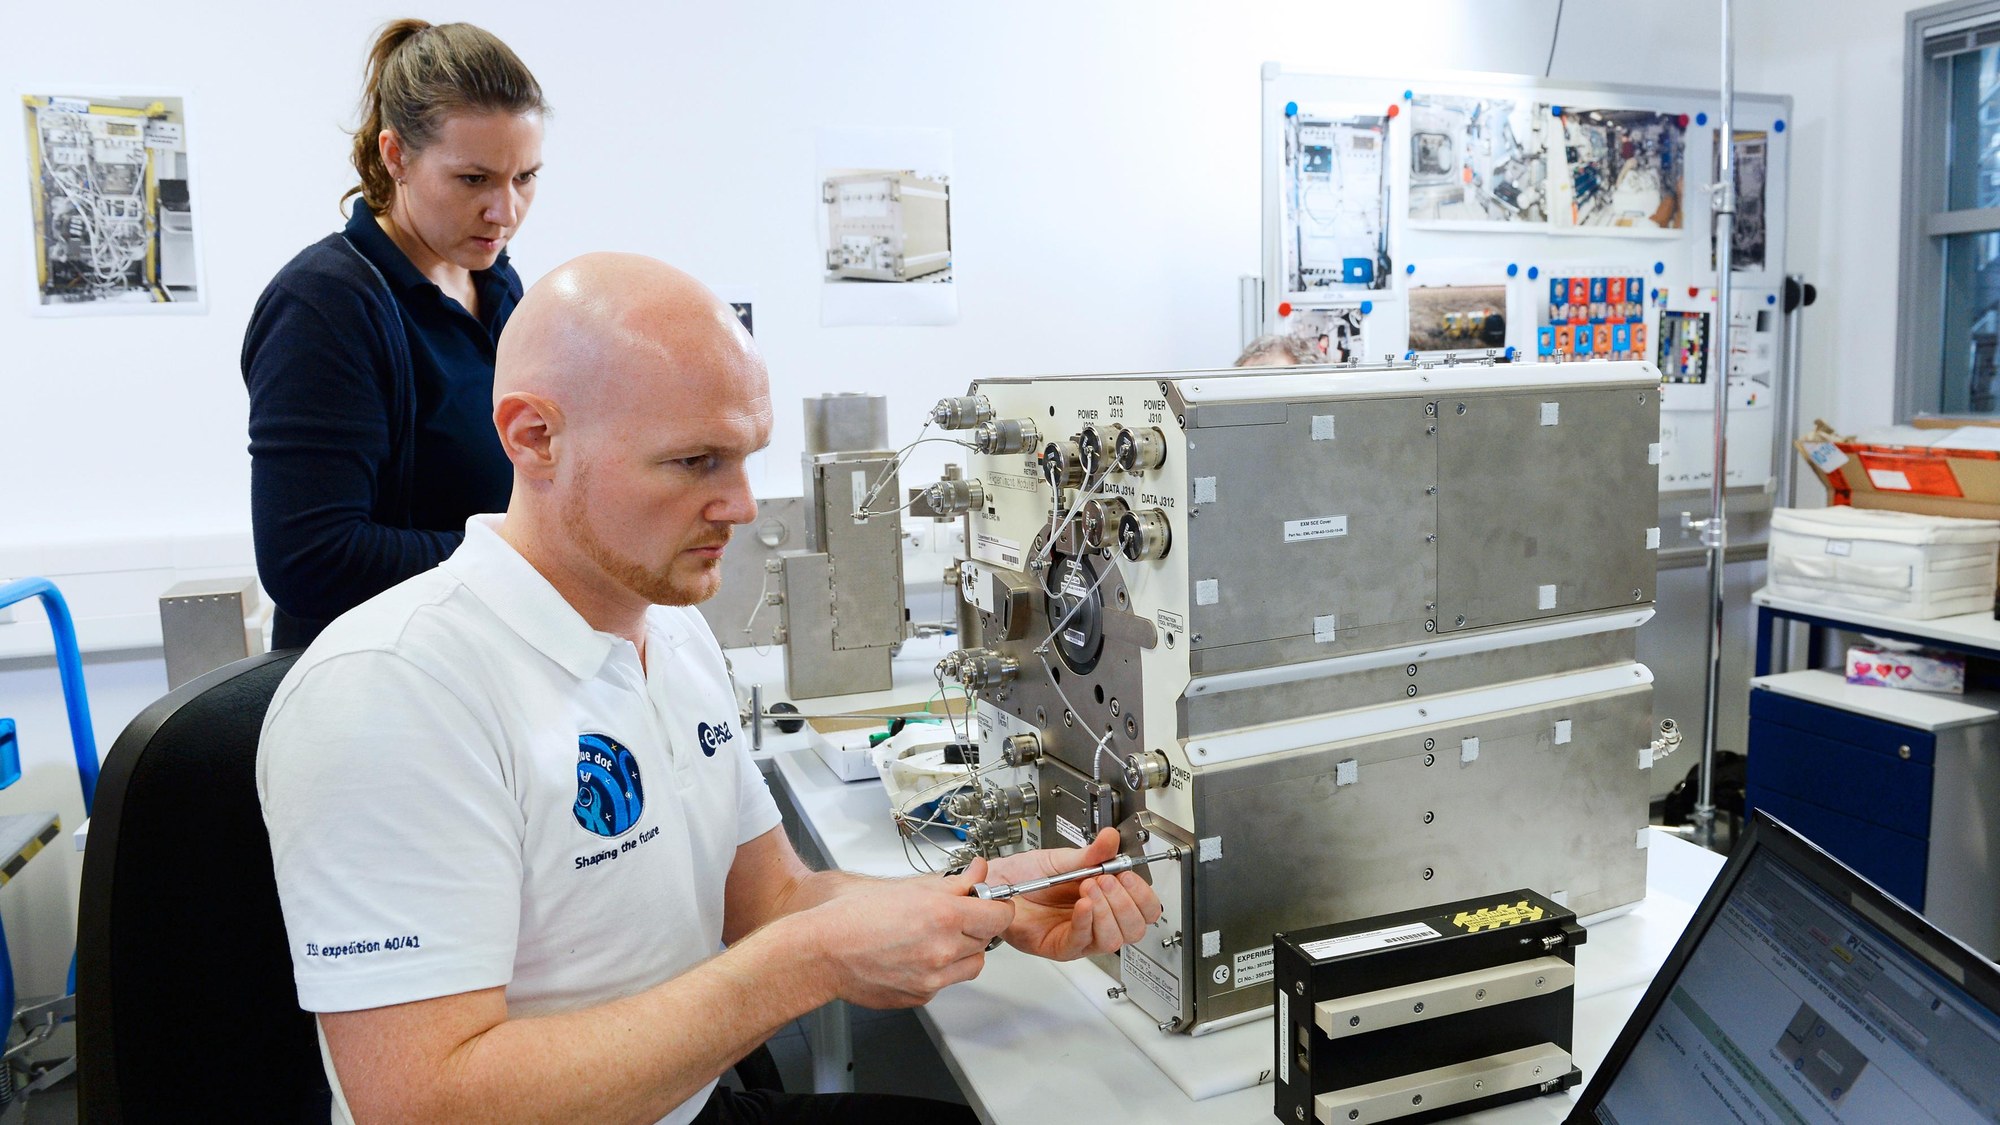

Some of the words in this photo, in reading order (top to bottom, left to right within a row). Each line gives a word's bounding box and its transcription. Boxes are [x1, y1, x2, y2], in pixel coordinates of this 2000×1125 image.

[1108, 396, 1124, 406] DATA
[1144, 400, 1166, 410] POWER
[1078, 410, 1098, 420] POWER
[1110, 408, 1124, 418] J313
[1148, 413, 1162, 423] J310
[1104, 483, 1120, 493] DATA
[1121, 486, 1135, 496] J314
[1142, 494, 1158, 504] DATA
[1160, 496, 1175, 508] J312
[594, 752, 612, 772] dot
[1171, 764, 1190, 782] POWER
[575, 848, 618, 870] Shaping
[621, 838, 637, 853] the
[638, 826, 660, 844] future
[322, 940, 380, 958] expedition
[384, 936, 420, 950] 40/41
